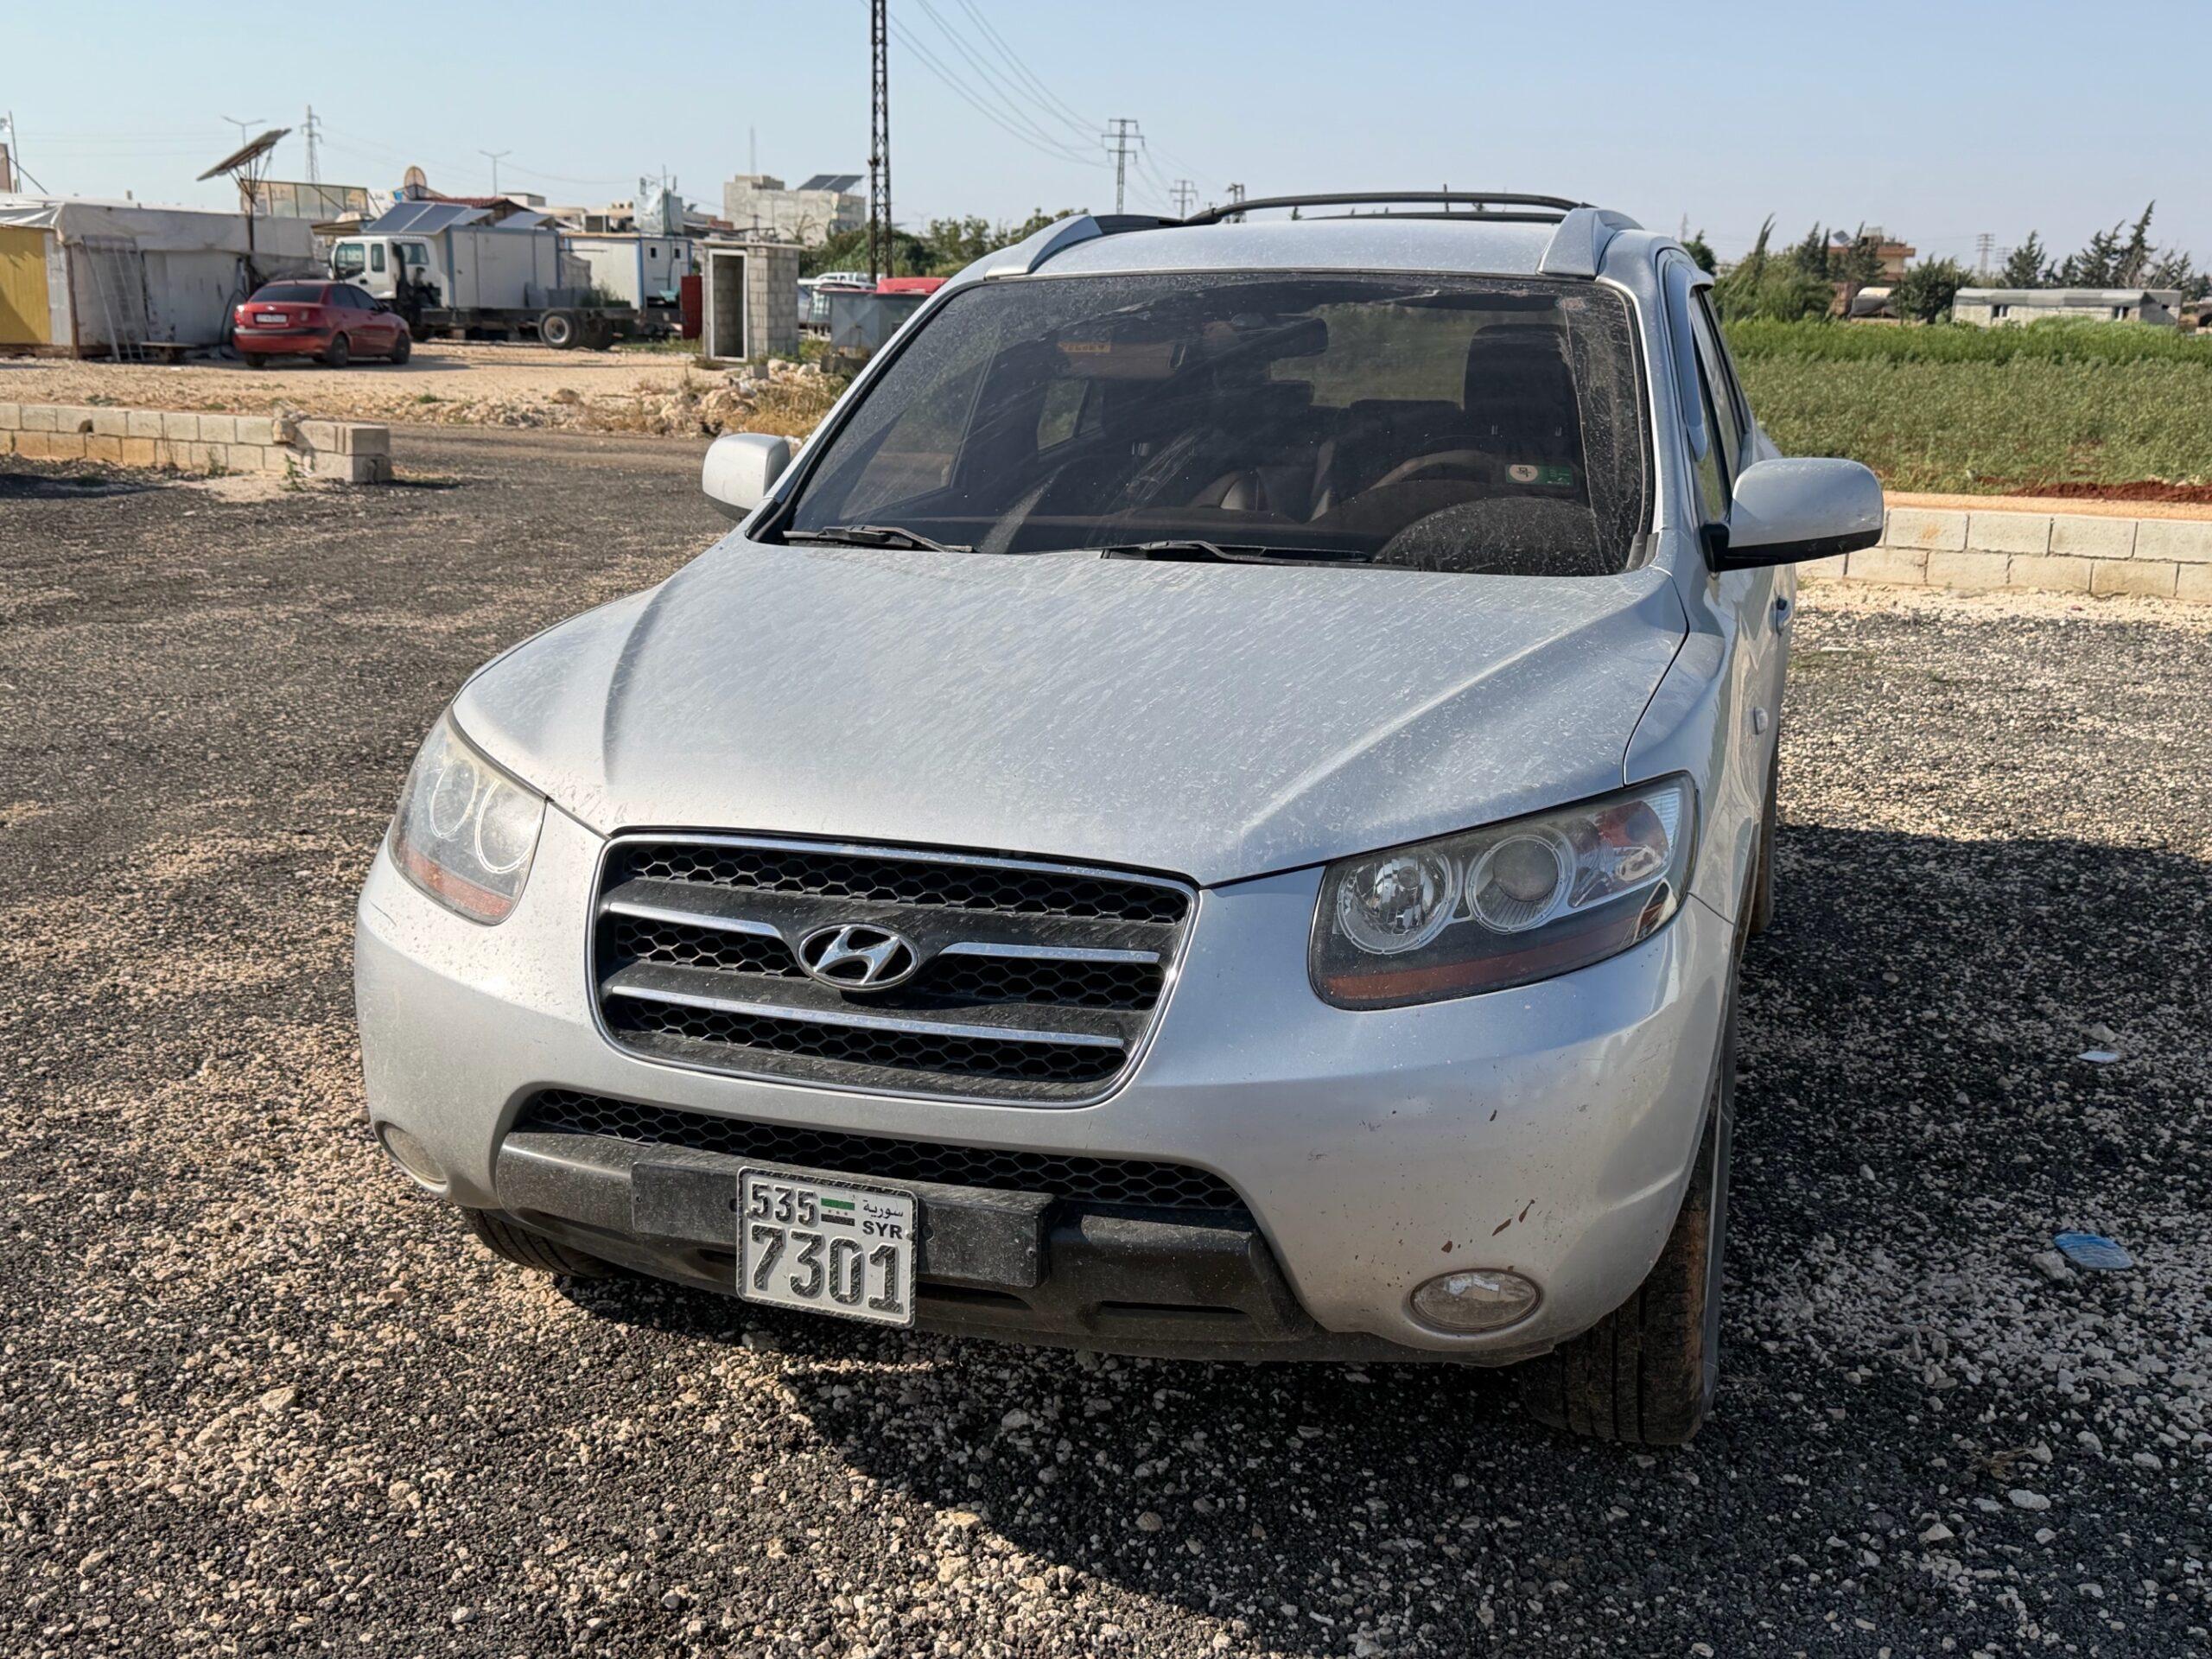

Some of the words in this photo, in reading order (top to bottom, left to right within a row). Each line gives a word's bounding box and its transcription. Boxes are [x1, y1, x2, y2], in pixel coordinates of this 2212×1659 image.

[749, 1182, 815, 1225] 535
[862, 1198, 904, 1219] سورية
[862, 1220, 903, 1239] SYR
[751, 1222, 904, 1314] 7301
